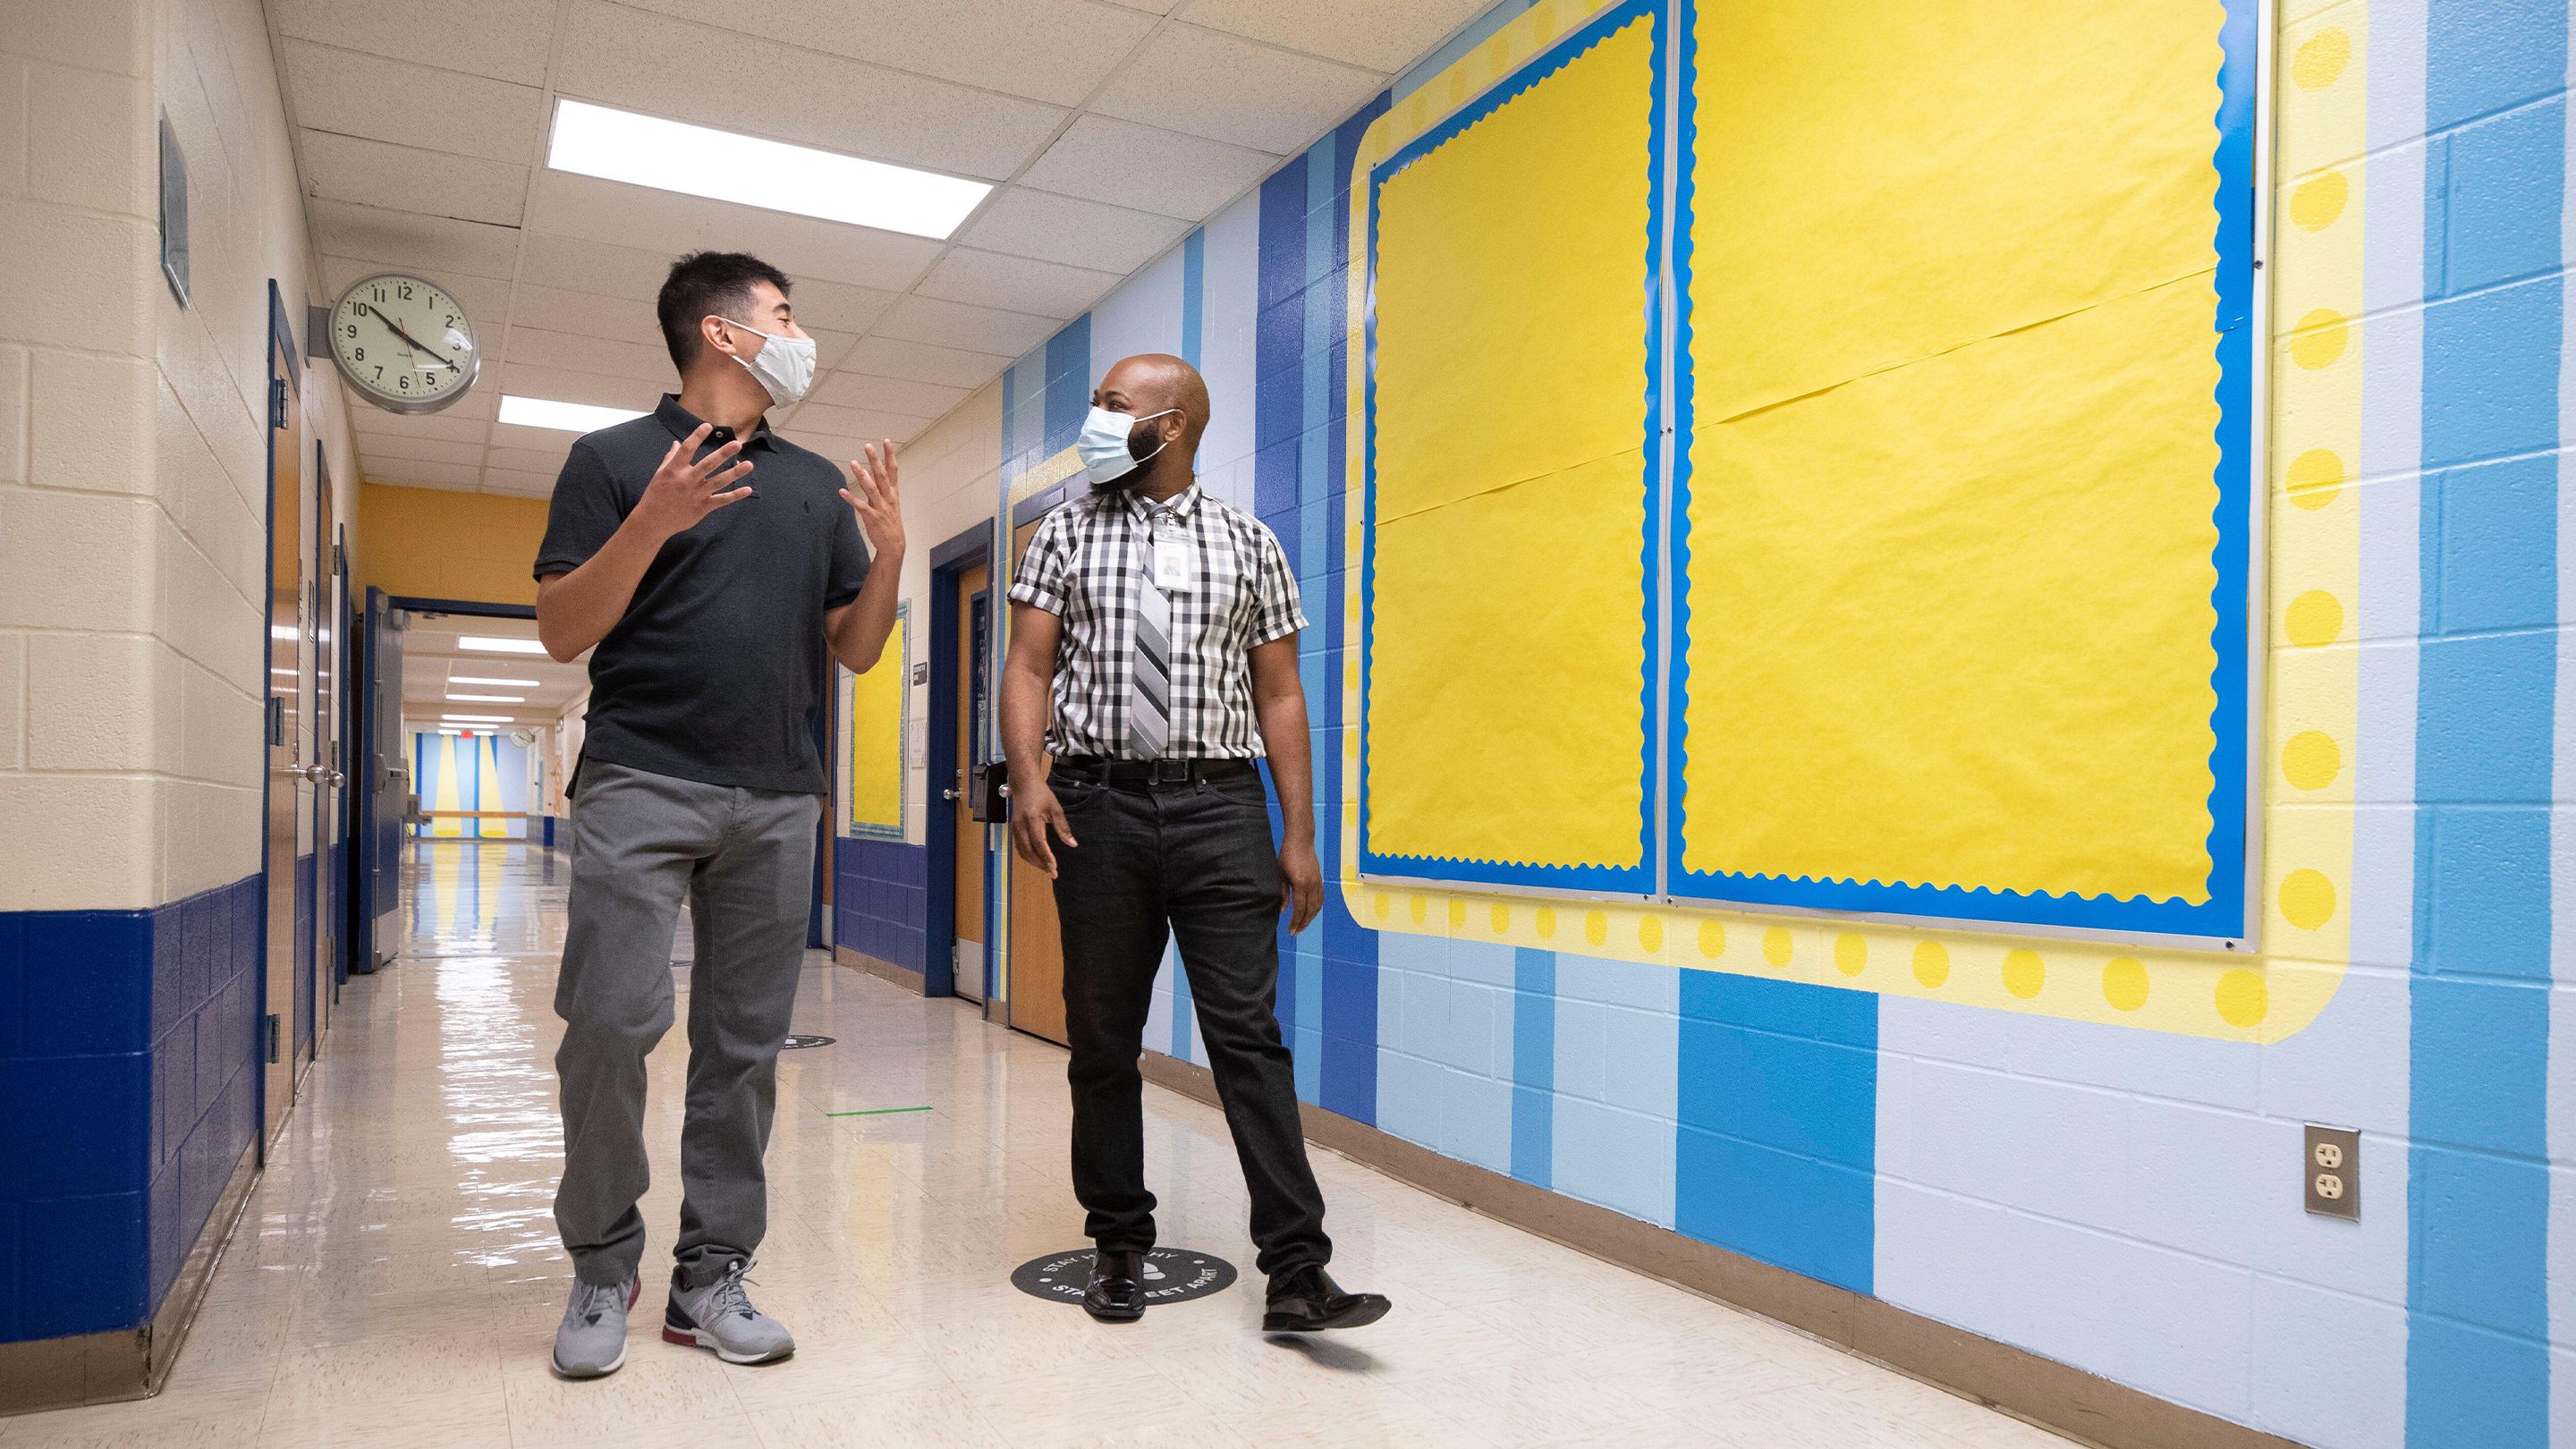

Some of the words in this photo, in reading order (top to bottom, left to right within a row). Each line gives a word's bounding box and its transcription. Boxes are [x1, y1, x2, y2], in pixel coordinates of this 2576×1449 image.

[374, 288, 386, 303] 11
[398, 285, 412, 301] 12
[352, 301, 368, 317] 10
[428, 296, 433, 309] 1
[445, 315, 454, 328] 2
[347, 325, 357, 338] 9
[453, 337, 462, 351] 3
[355, 347, 365, 361] 8
[374, 366, 384, 380] 7
[445, 360, 456, 373] 4
[399, 376, 409, 389] 6
[426, 372, 436, 386] 5
[1042, 1257, 1079, 1273] STAY
[1052, 1284, 1086, 1297] STA
[1144, 1286, 1184, 1298] EET
[1186, 1267, 1217, 1289] APART
